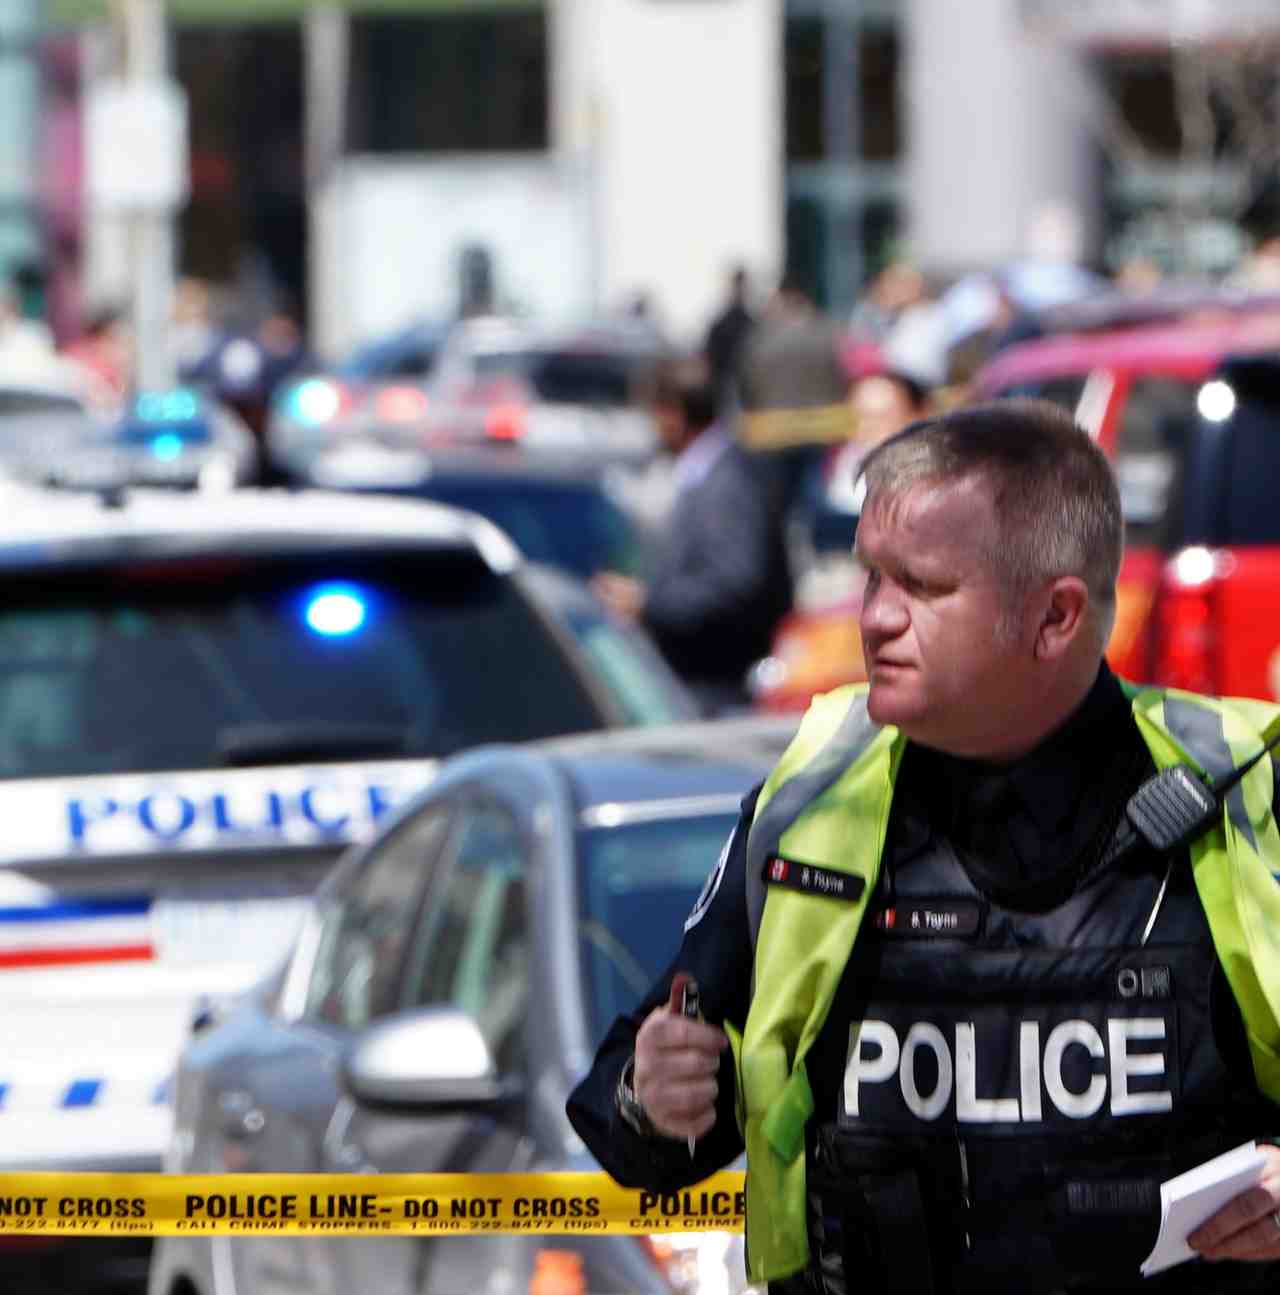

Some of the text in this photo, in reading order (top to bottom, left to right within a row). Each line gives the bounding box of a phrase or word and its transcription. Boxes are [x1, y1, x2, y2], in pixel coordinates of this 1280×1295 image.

[843, 1016, 1173, 1123] POLICE
[60, 1199, 145, 1217] CROSS
[185, 1195, 297, 1218] POLICE
[404, 1200, 438, 1218] DO
[451, 1199, 501, 1218] NOT
[514, 1197, 599, 1217] CROSS
